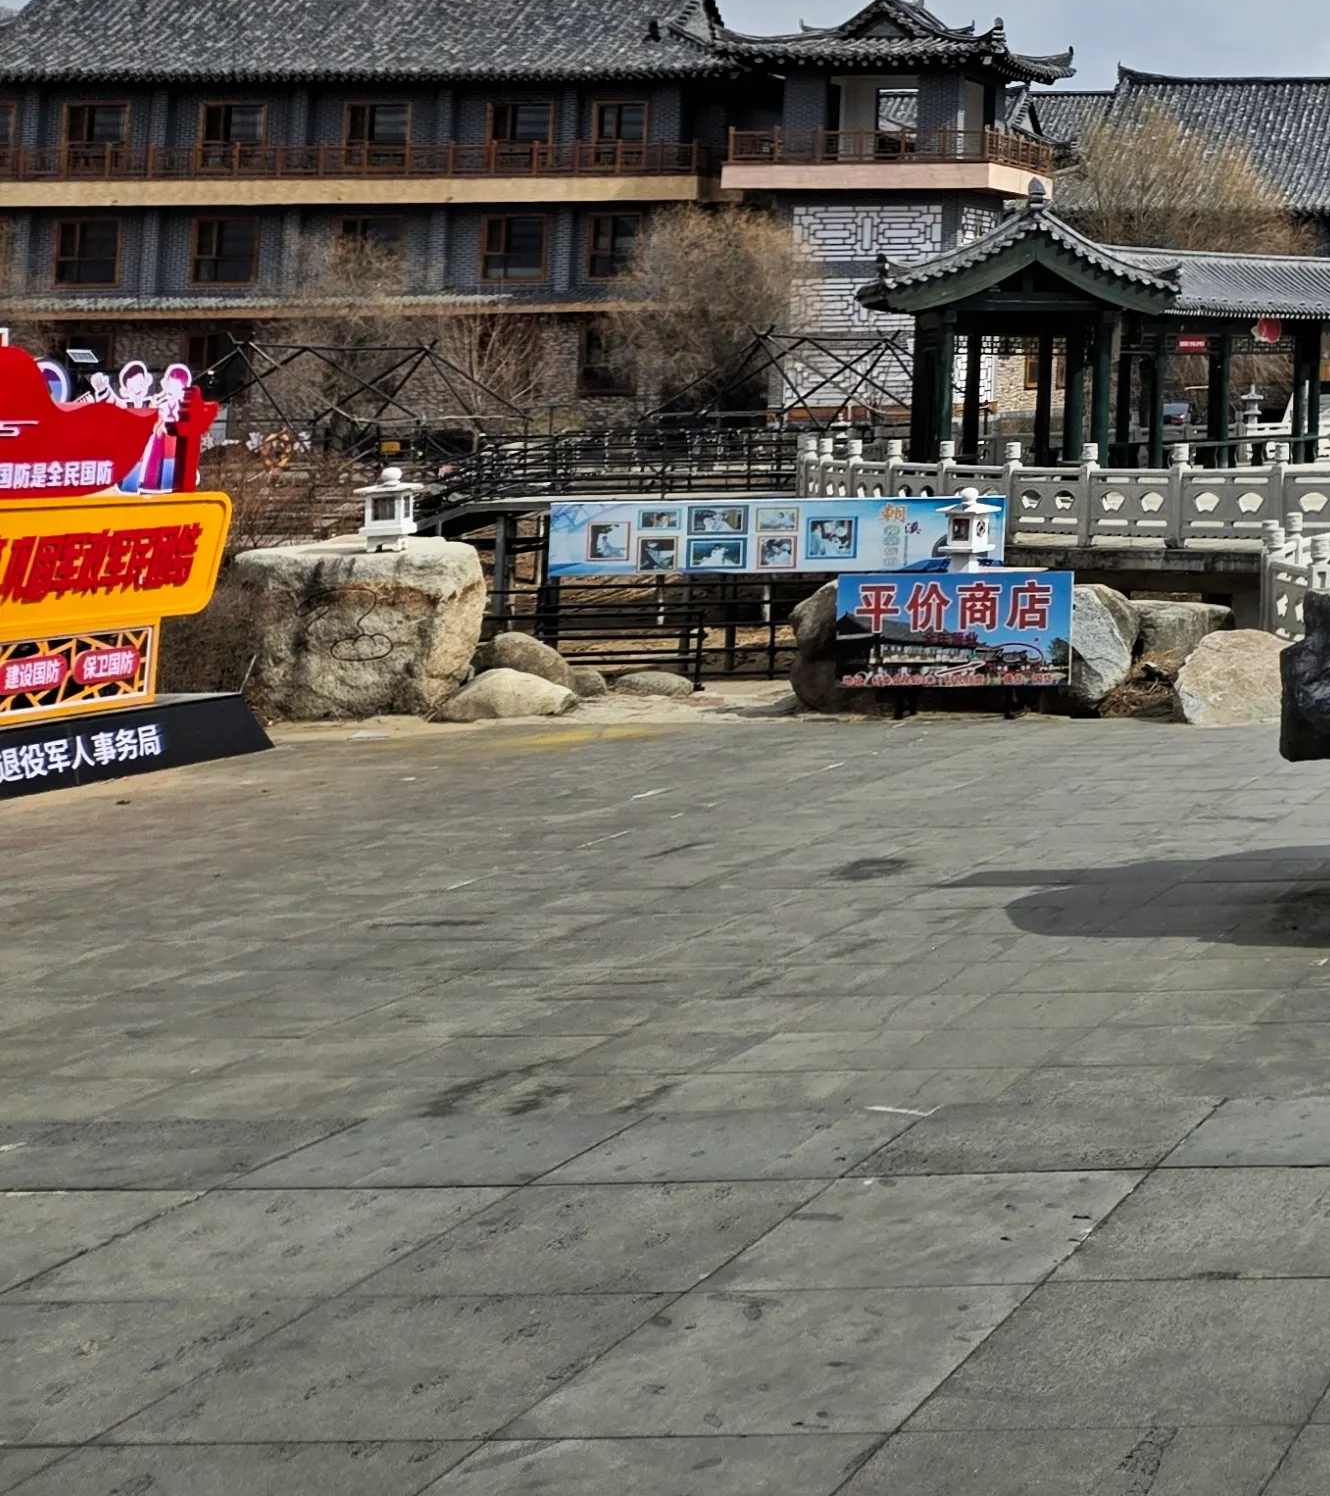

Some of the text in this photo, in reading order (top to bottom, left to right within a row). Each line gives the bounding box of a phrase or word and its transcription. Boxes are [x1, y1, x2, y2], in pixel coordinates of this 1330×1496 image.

[0, 460, 113, 489] 国防是全民国防
[0, 522, 203, 605] 巩固军政军民团结
[854, 579, 1053, 633] 平价商店
[4, 658, 61, 690] 建设国防
[82, 651, 136, 680] 保卫国防
[0, 724, 162, 783] 退役军人事务局
